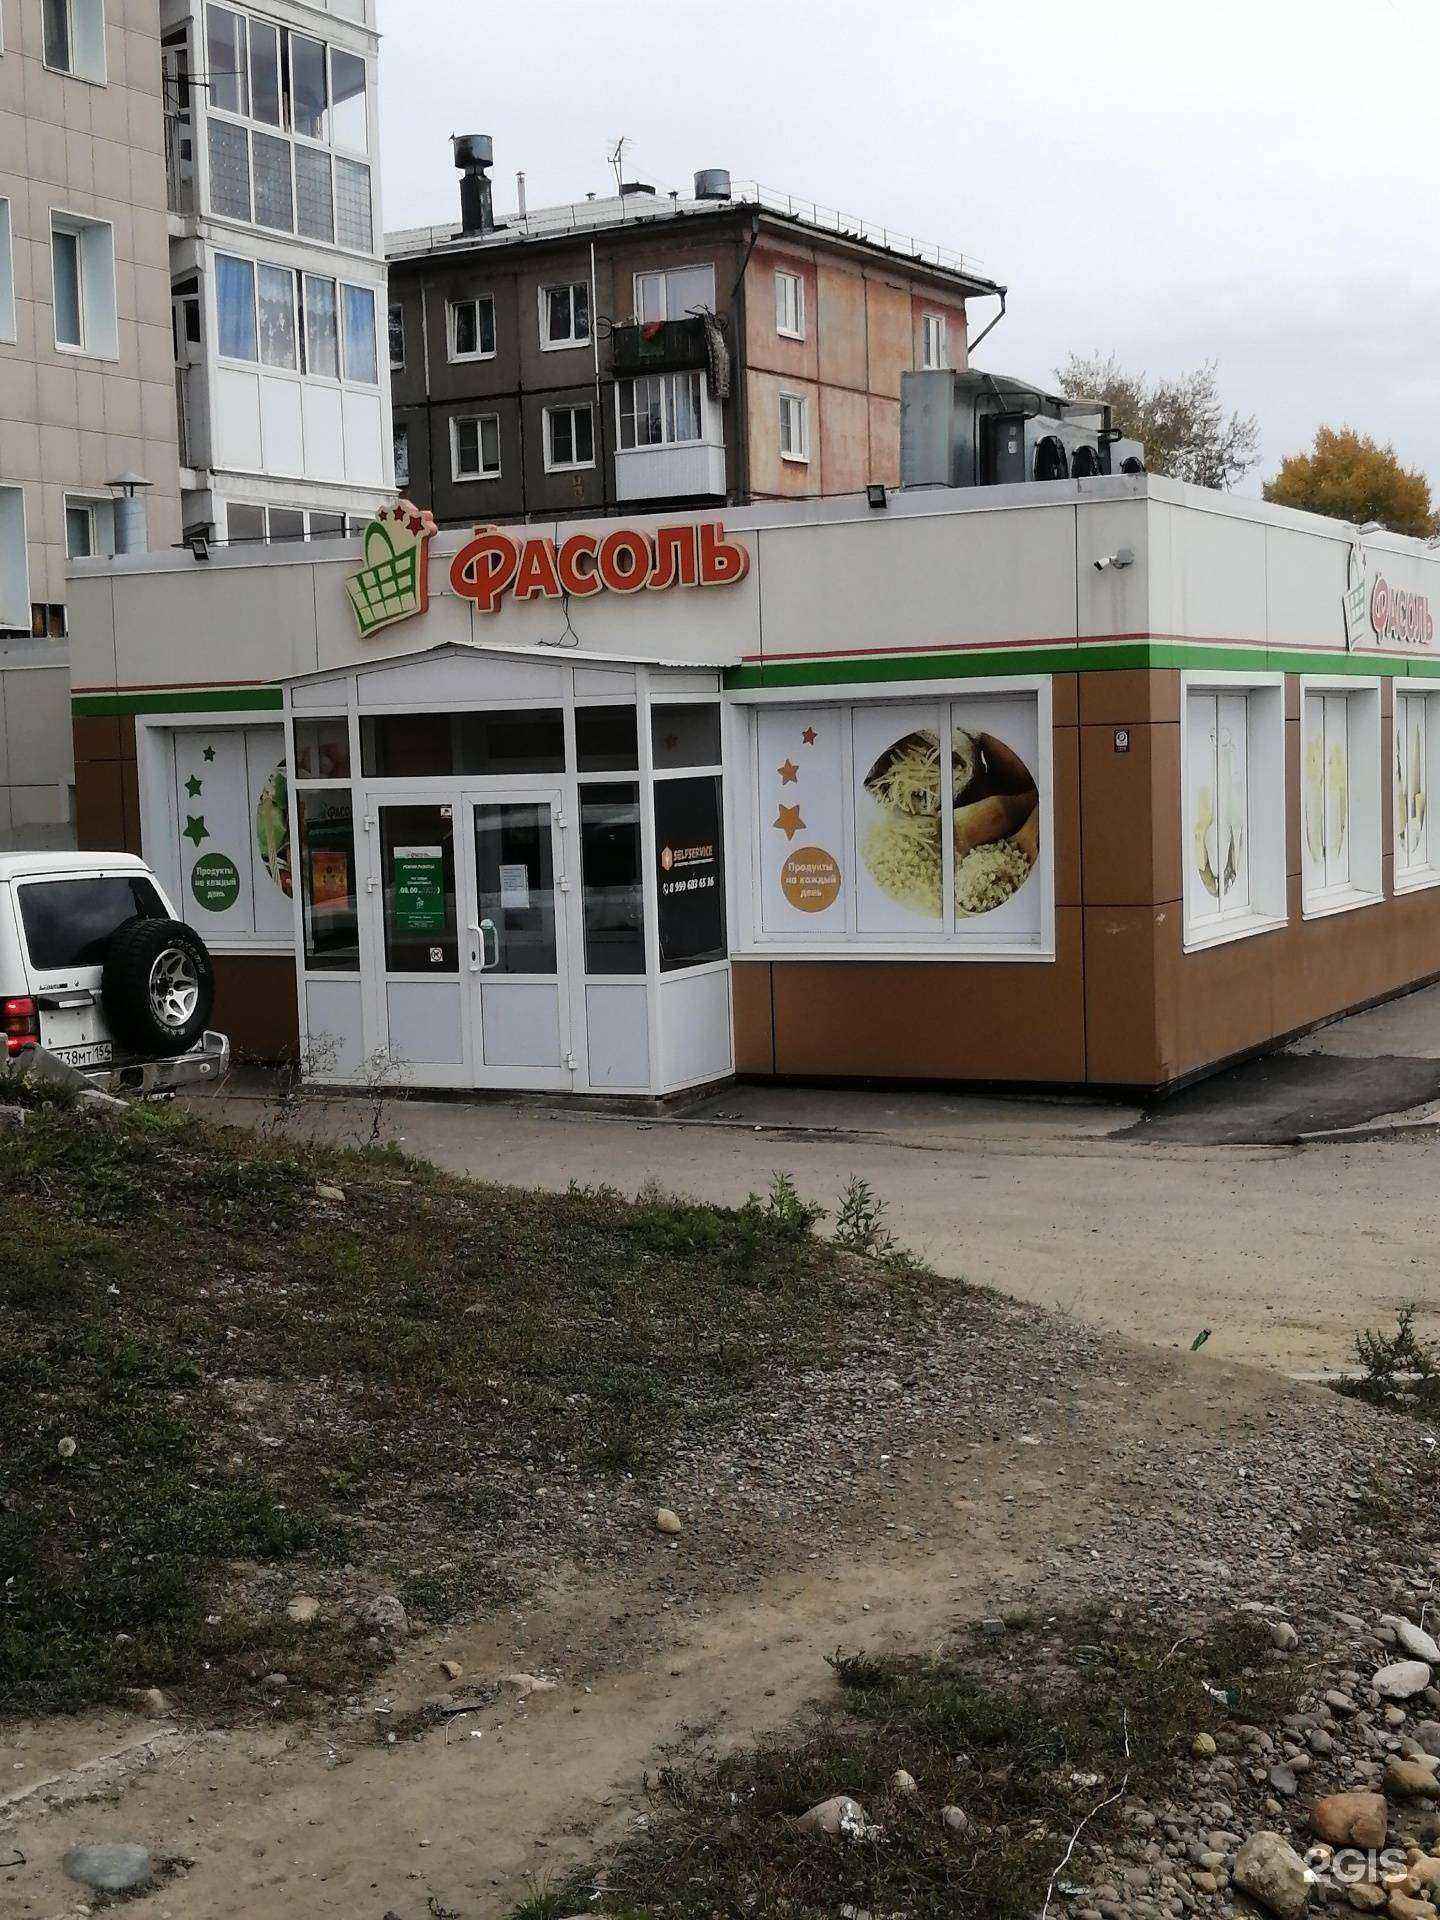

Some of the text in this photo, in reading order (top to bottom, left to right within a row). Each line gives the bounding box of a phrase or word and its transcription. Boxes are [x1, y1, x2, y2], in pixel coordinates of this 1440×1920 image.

[450, 523, 751, 613] ФАСОЛЬ
[1370, 571, 1434, 646] ФАСОЛЬ
[196, 866, 234, 878] Продукты
[788, 862, 834, 874] Продукты
[194, 877, 237, 887] на каждый
[786, 874, 837, 885] на каждый
[207, 891, 226, 900] день
[800, 889, 822, 899] день
